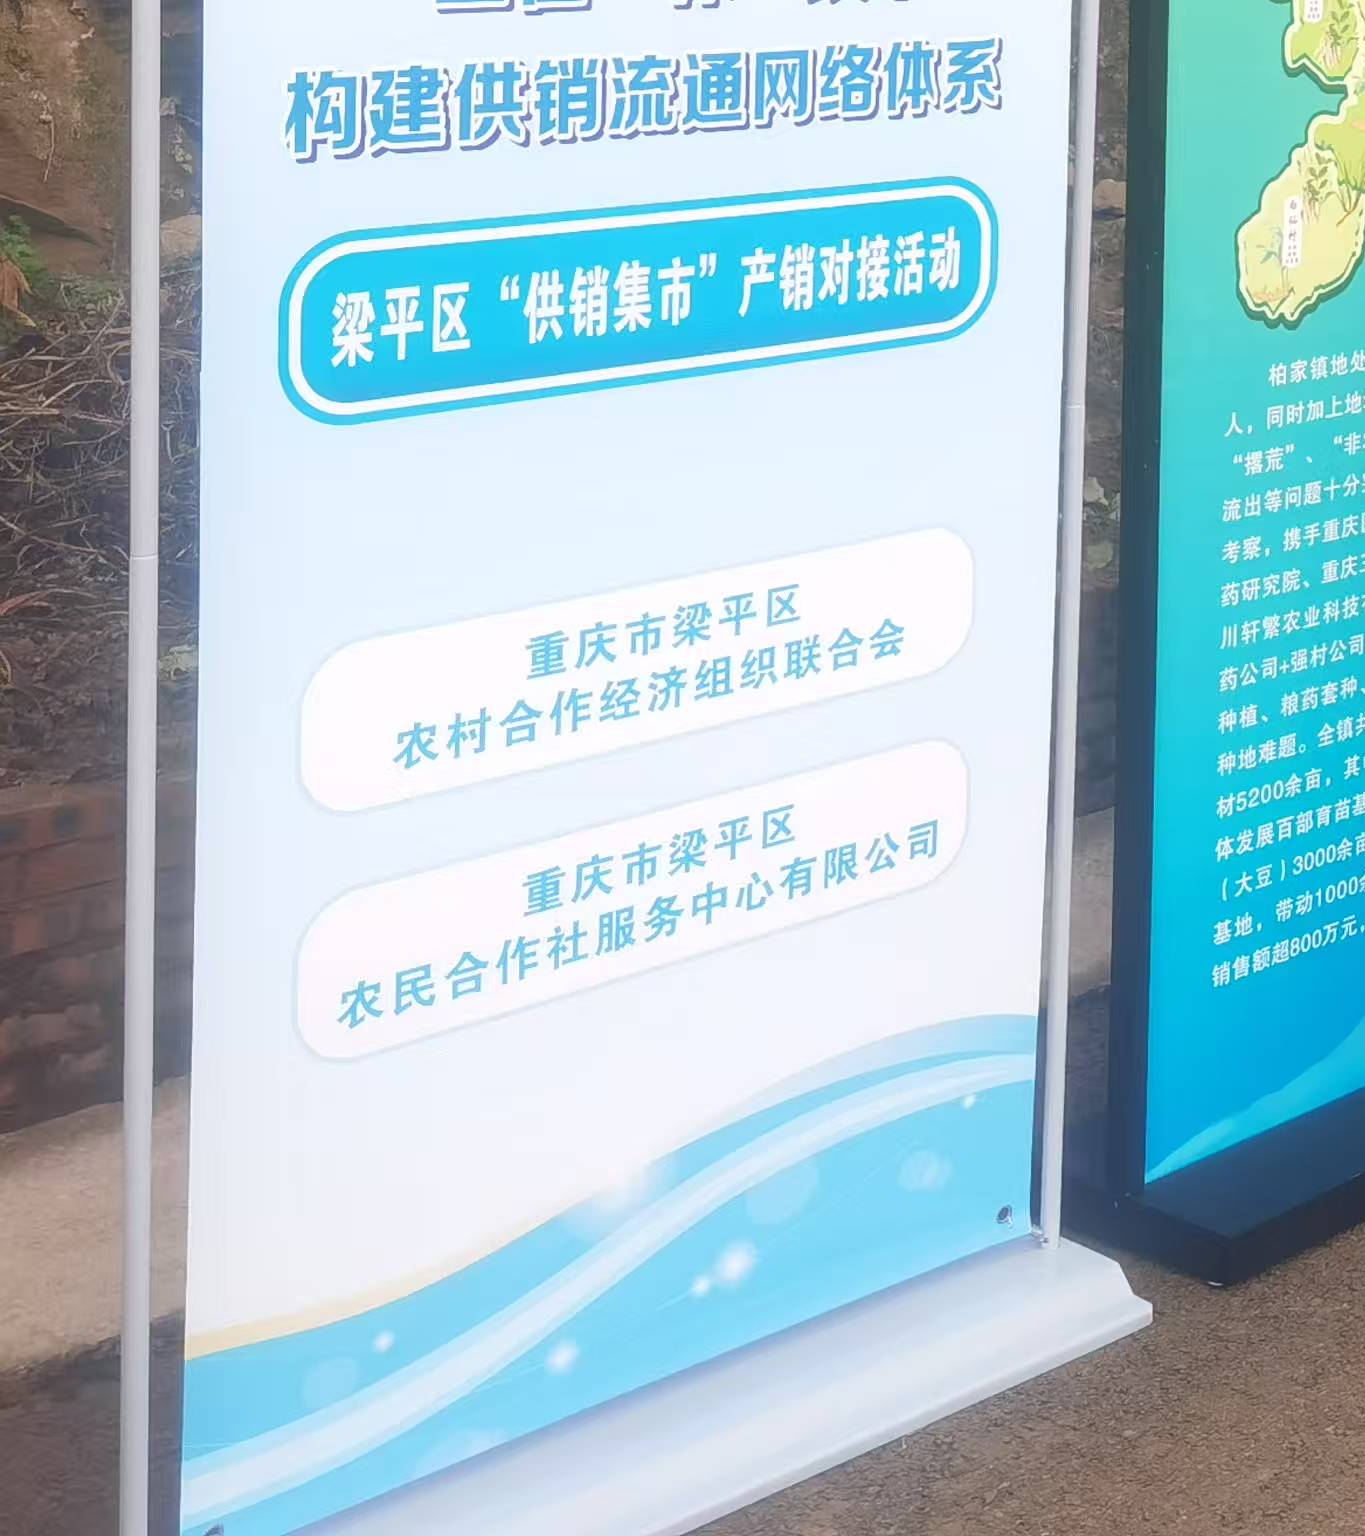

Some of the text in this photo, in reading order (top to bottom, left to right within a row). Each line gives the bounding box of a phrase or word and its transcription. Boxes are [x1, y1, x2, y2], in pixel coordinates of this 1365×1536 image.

[283, 36, 1003, 164] 构建供销流通网络体系
[524, 582, 802, 680] 重庆市梁平区
[391, 618, 906, 773] 农村合作经济组织联合会
[335, 819, 941, 1031] 农民合作社服务中心有限公司
[521, 804, 797, 919] 重庆市梁平区
